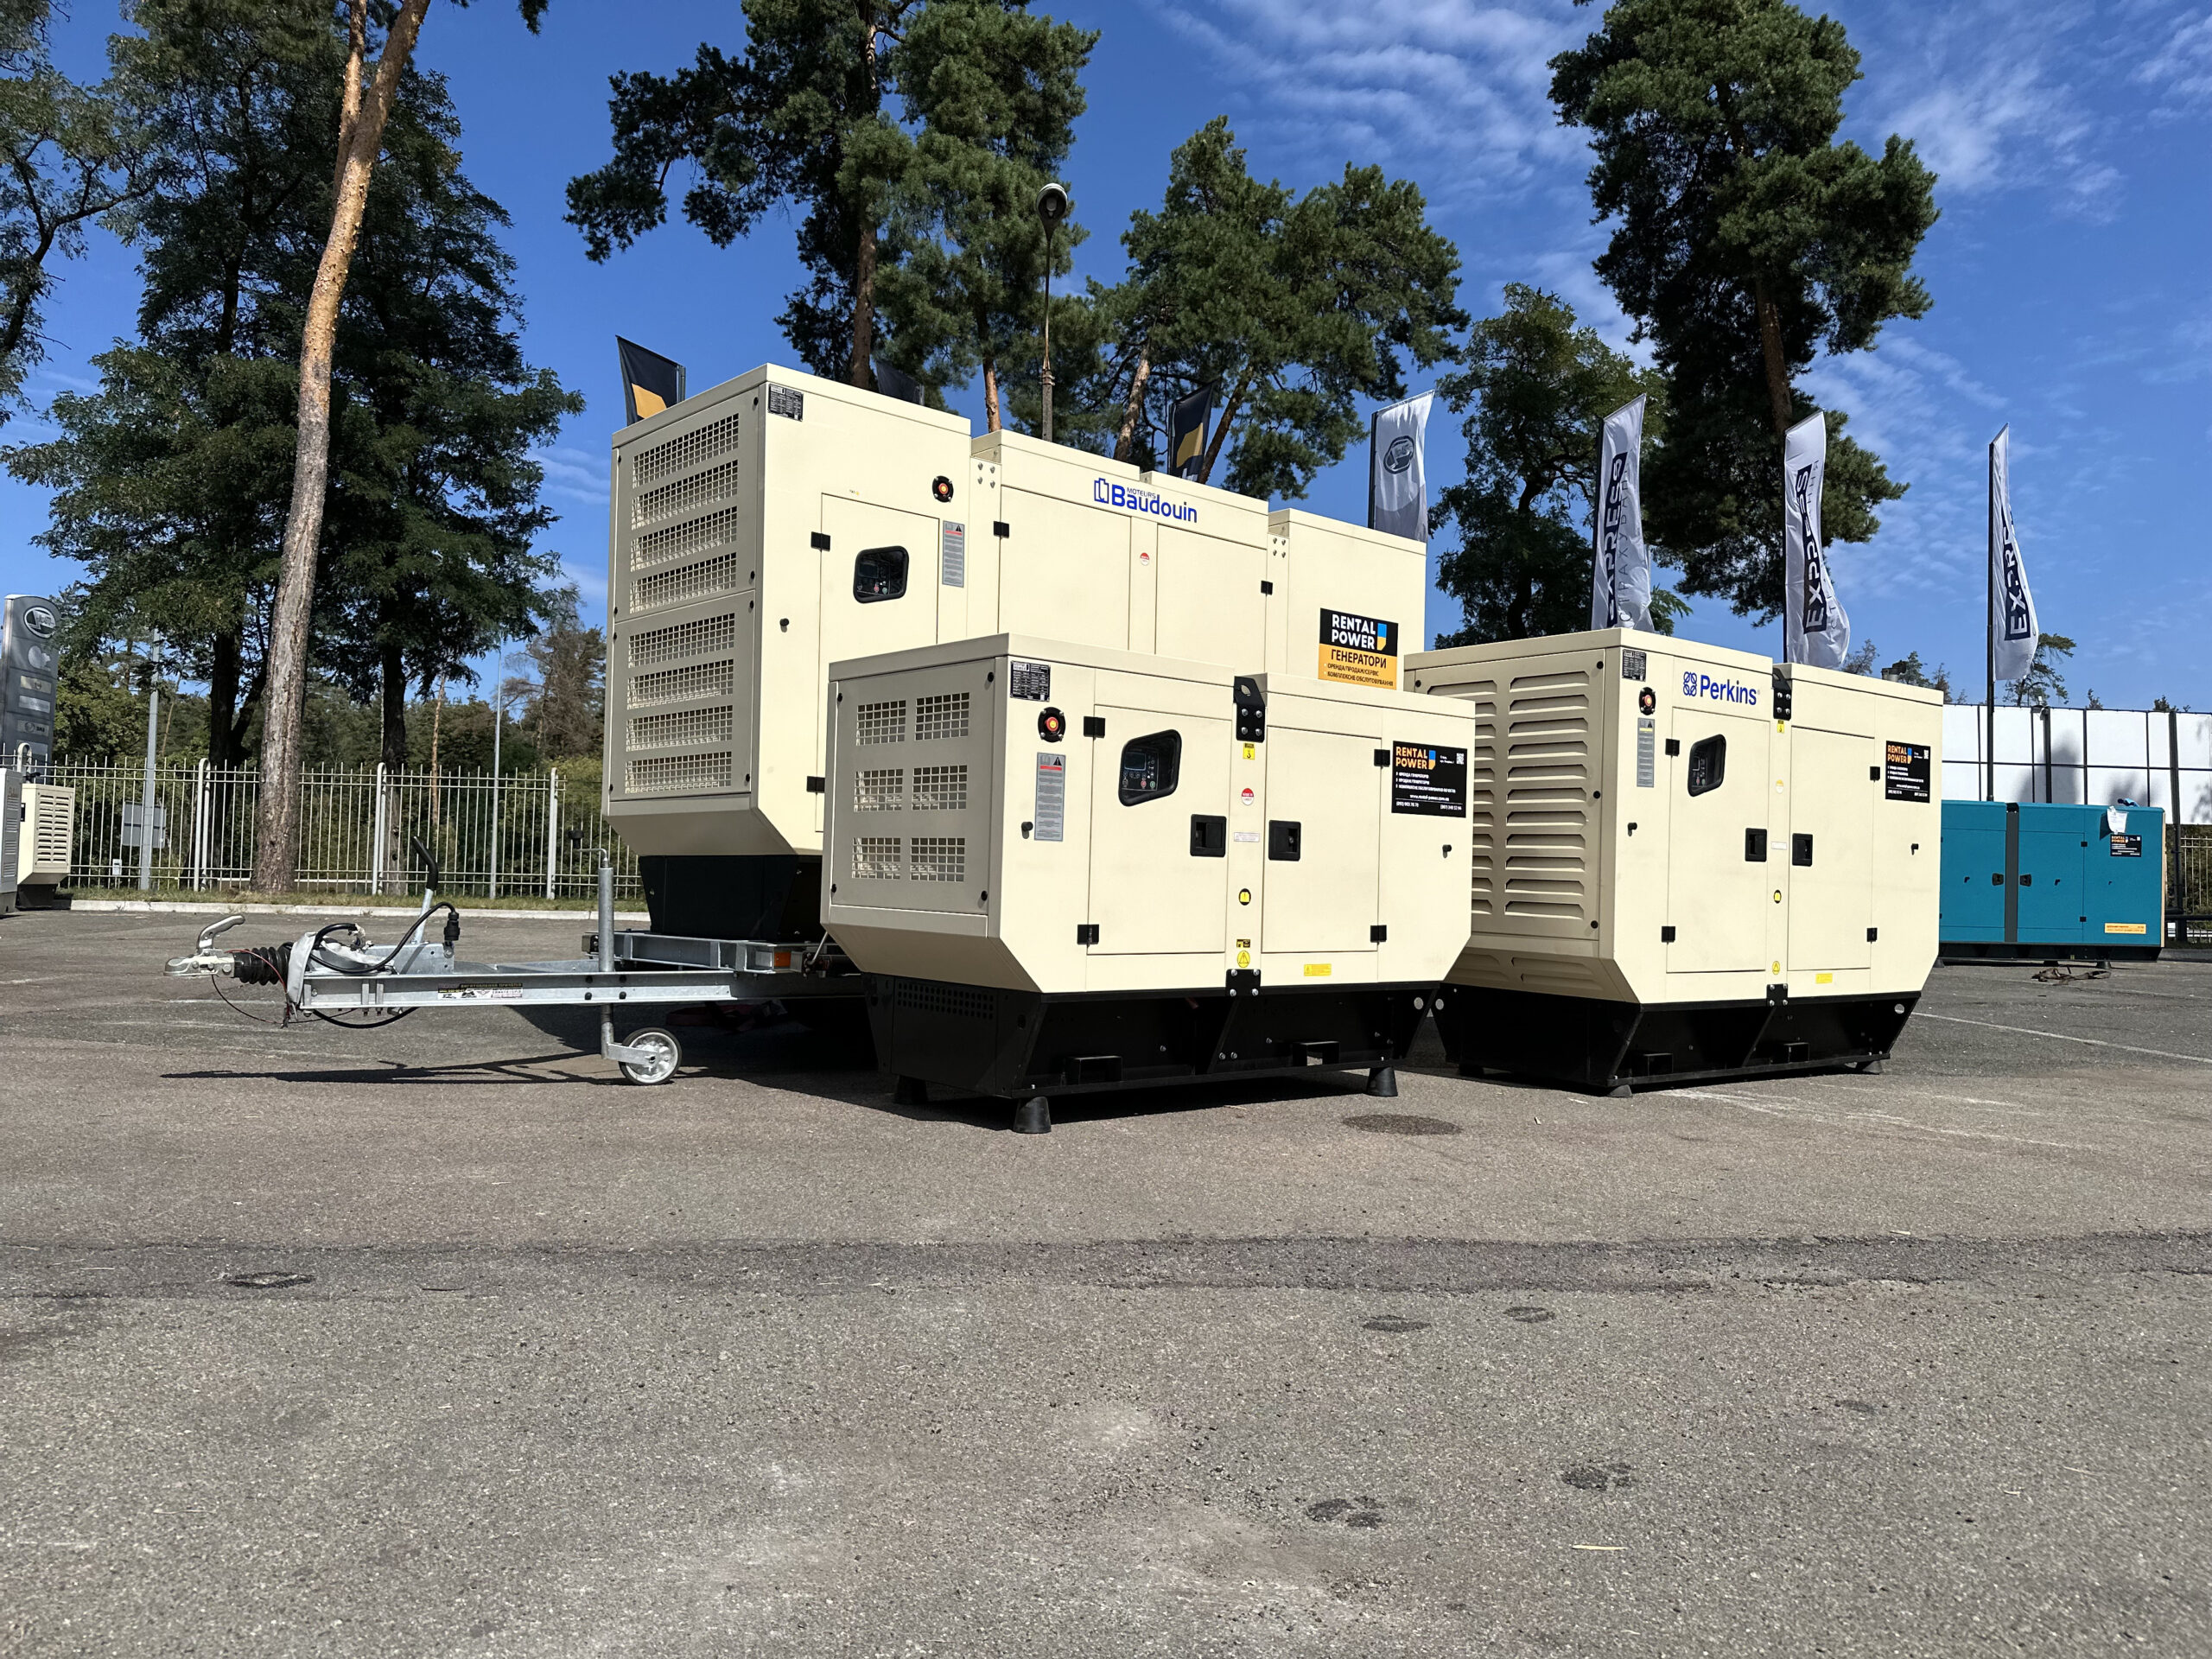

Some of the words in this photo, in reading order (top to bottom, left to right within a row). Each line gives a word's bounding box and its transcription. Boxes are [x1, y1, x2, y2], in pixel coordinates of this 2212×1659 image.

[1127, 486, 1156, 499] MOTEURS
[1111, 484, 1198, 524] Baudouin
[1332, 613, 1376, 635] RENTAL
[1332, 629, 1375, 650] POWER
[1331, 649, 1387, 669] ГЕНЕРАТОРИ
[1700, 674, 1758, 705] Perkins
[1395, 746, 1427, 760] RENTAL
[1887, 745, 1907, 755] RENTAL
[1887, 753, 1907, 764] POWER
[1395, 757, 1427, 770] POWER
